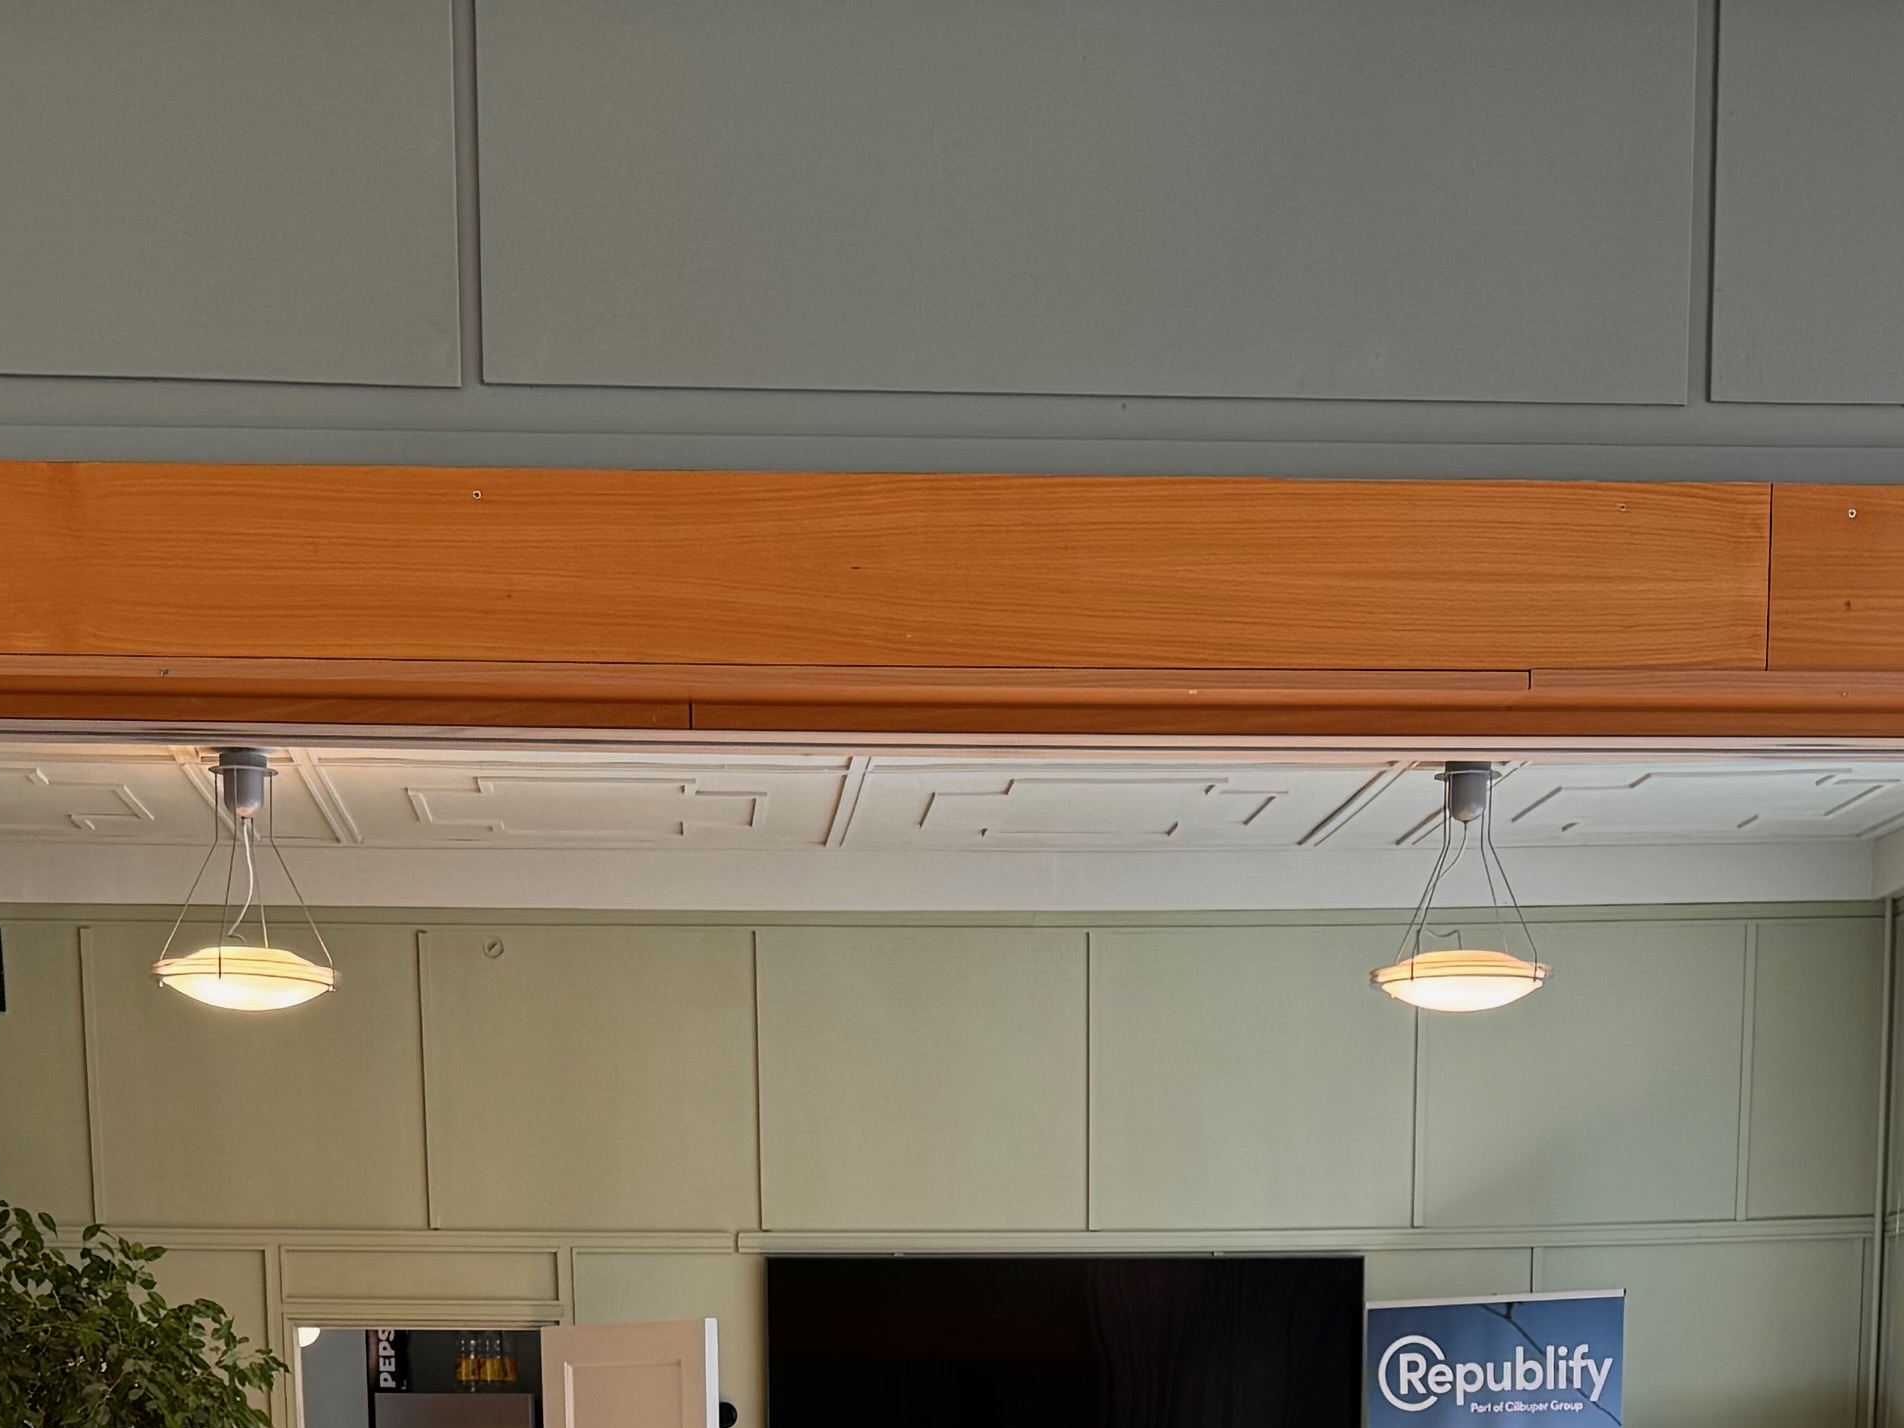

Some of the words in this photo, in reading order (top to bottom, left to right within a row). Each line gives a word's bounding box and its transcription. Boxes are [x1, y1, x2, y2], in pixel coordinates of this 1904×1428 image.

[1399, 1343, 1613, 1405] Republify
[1470, 1402, 1491, 1413] Part
[1493, 1401, 1504, 1413] of
[1550, 1400, 1584, 1413] Group
